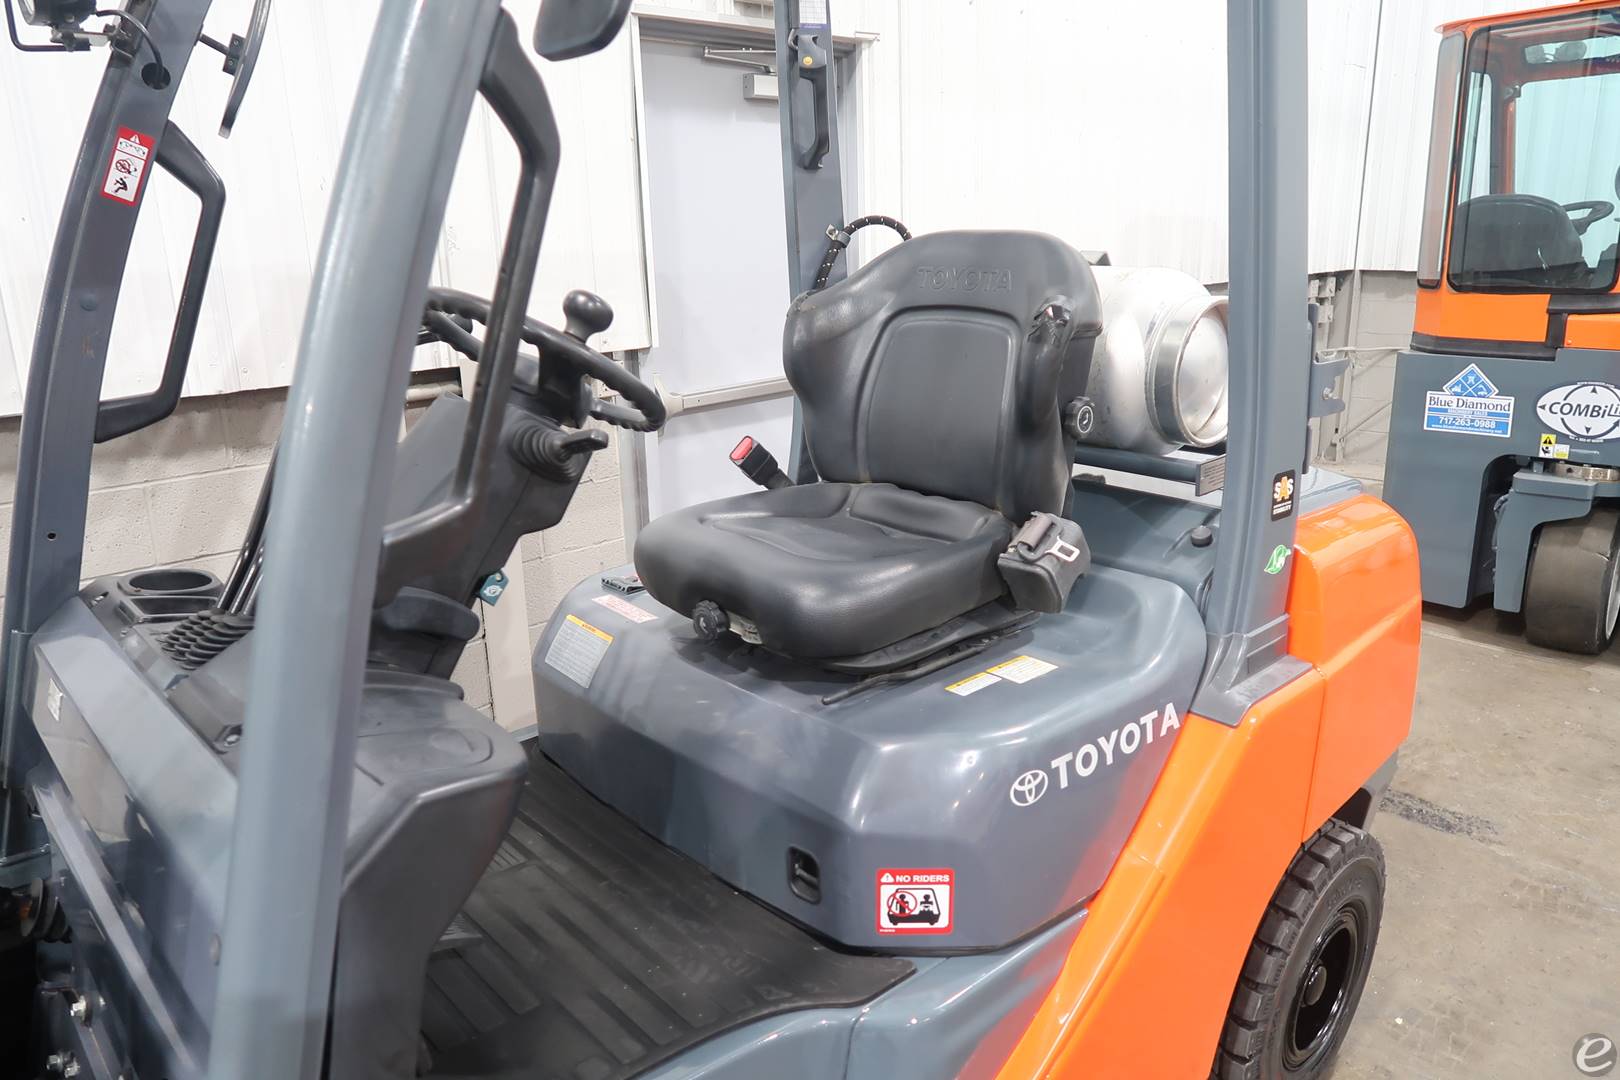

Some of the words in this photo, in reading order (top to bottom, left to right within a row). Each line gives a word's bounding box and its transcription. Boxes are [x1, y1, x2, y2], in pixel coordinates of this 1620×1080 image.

[917, 265, 1013, 292] TOYOTA
[1429, 396, 1454, 408] Blue
[1456, 398, 1511, 412] Diamond
[1549, 401, 1620, 418] COMBiLi
[1439, 416, 1496, 429] 717-263-0988
[1274, 476, 1294, 502] SAS
[1050, 702, 1181, 789] TOYOTA
[895, 874, 911, 883] NO
[912, 874, 950, 883] RIDERS
